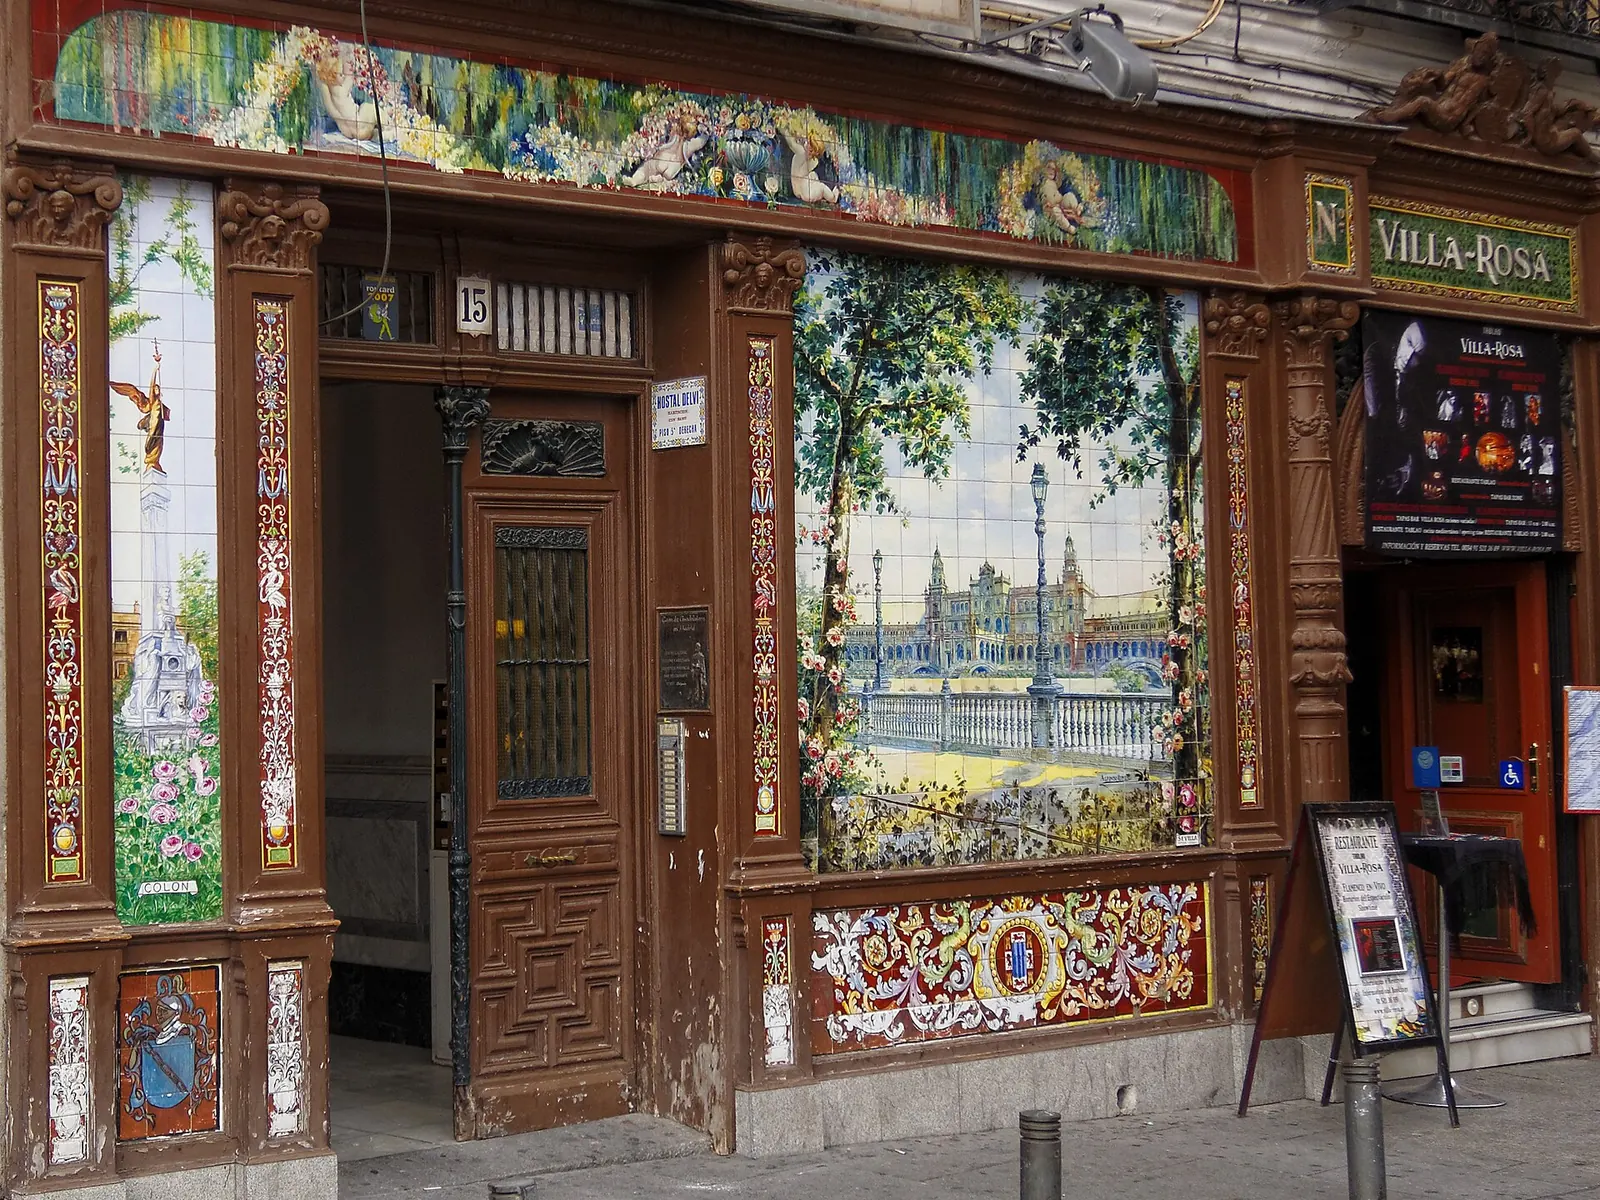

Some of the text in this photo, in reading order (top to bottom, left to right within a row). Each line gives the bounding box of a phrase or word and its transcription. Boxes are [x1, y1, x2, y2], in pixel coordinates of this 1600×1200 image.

[1376, 218, 1551, 286] VILLA-ROSA
[460, 287, 487, 323] 15
[1461, 337, 1524, 360] VILLA-ROSA
[657, 390, 699, 410] HOSTAL DELVI
[659, 427, 670, 437] PISO
[678, 423, 698, 435] DERECHA
[1334, 835, 1379, 850] RESTAURANTE
[1338, 862, 1384, 876] VILLA-ROSA
[144, 881, 190, 893] COLON
